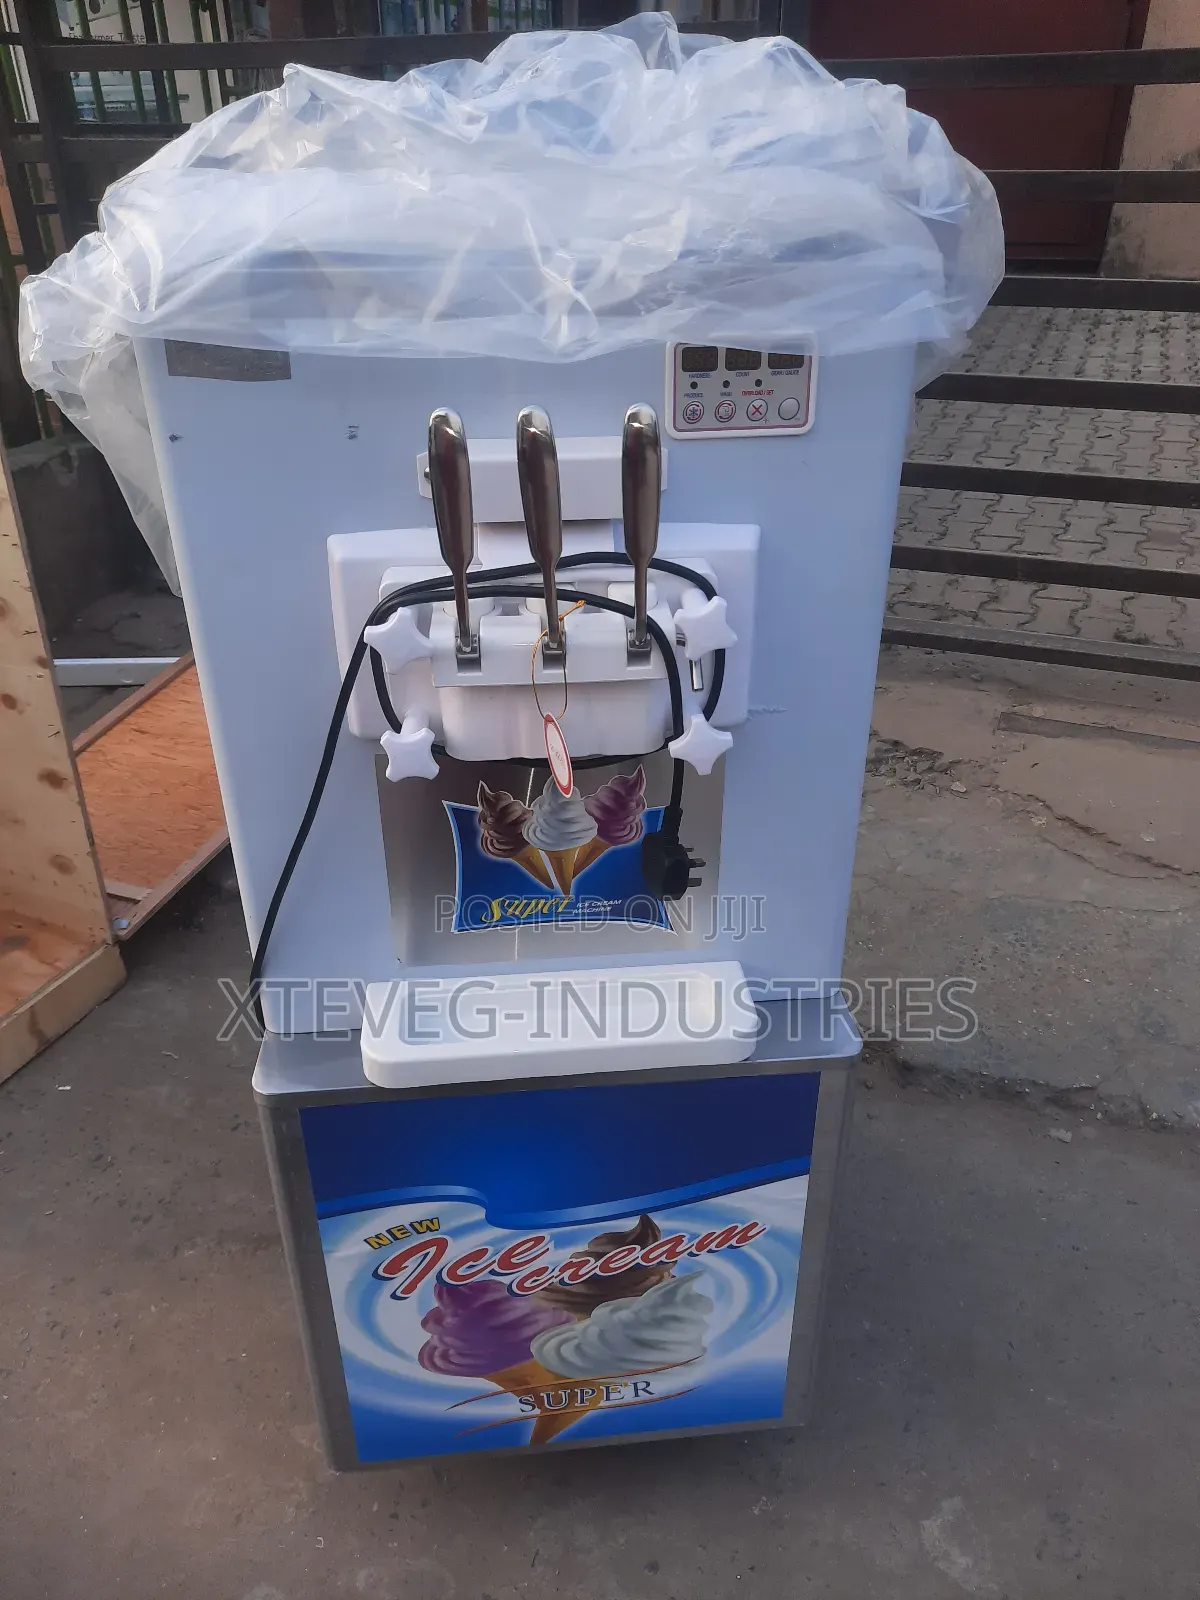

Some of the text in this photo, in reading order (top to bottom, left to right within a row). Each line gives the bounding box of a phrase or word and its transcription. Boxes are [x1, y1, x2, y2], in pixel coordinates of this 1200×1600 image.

[480, 897, 573, 922] Super
[573, 906, 612, 914] MACHINE
[592, 899, 622, 907] CREAM
[364, 1217, 440, 1250] NEW
[372, 1233, 553, 1300] Ice
[507, 1220, 768, 1297] cream
[518, 1380, 655, 1414] SUPER
